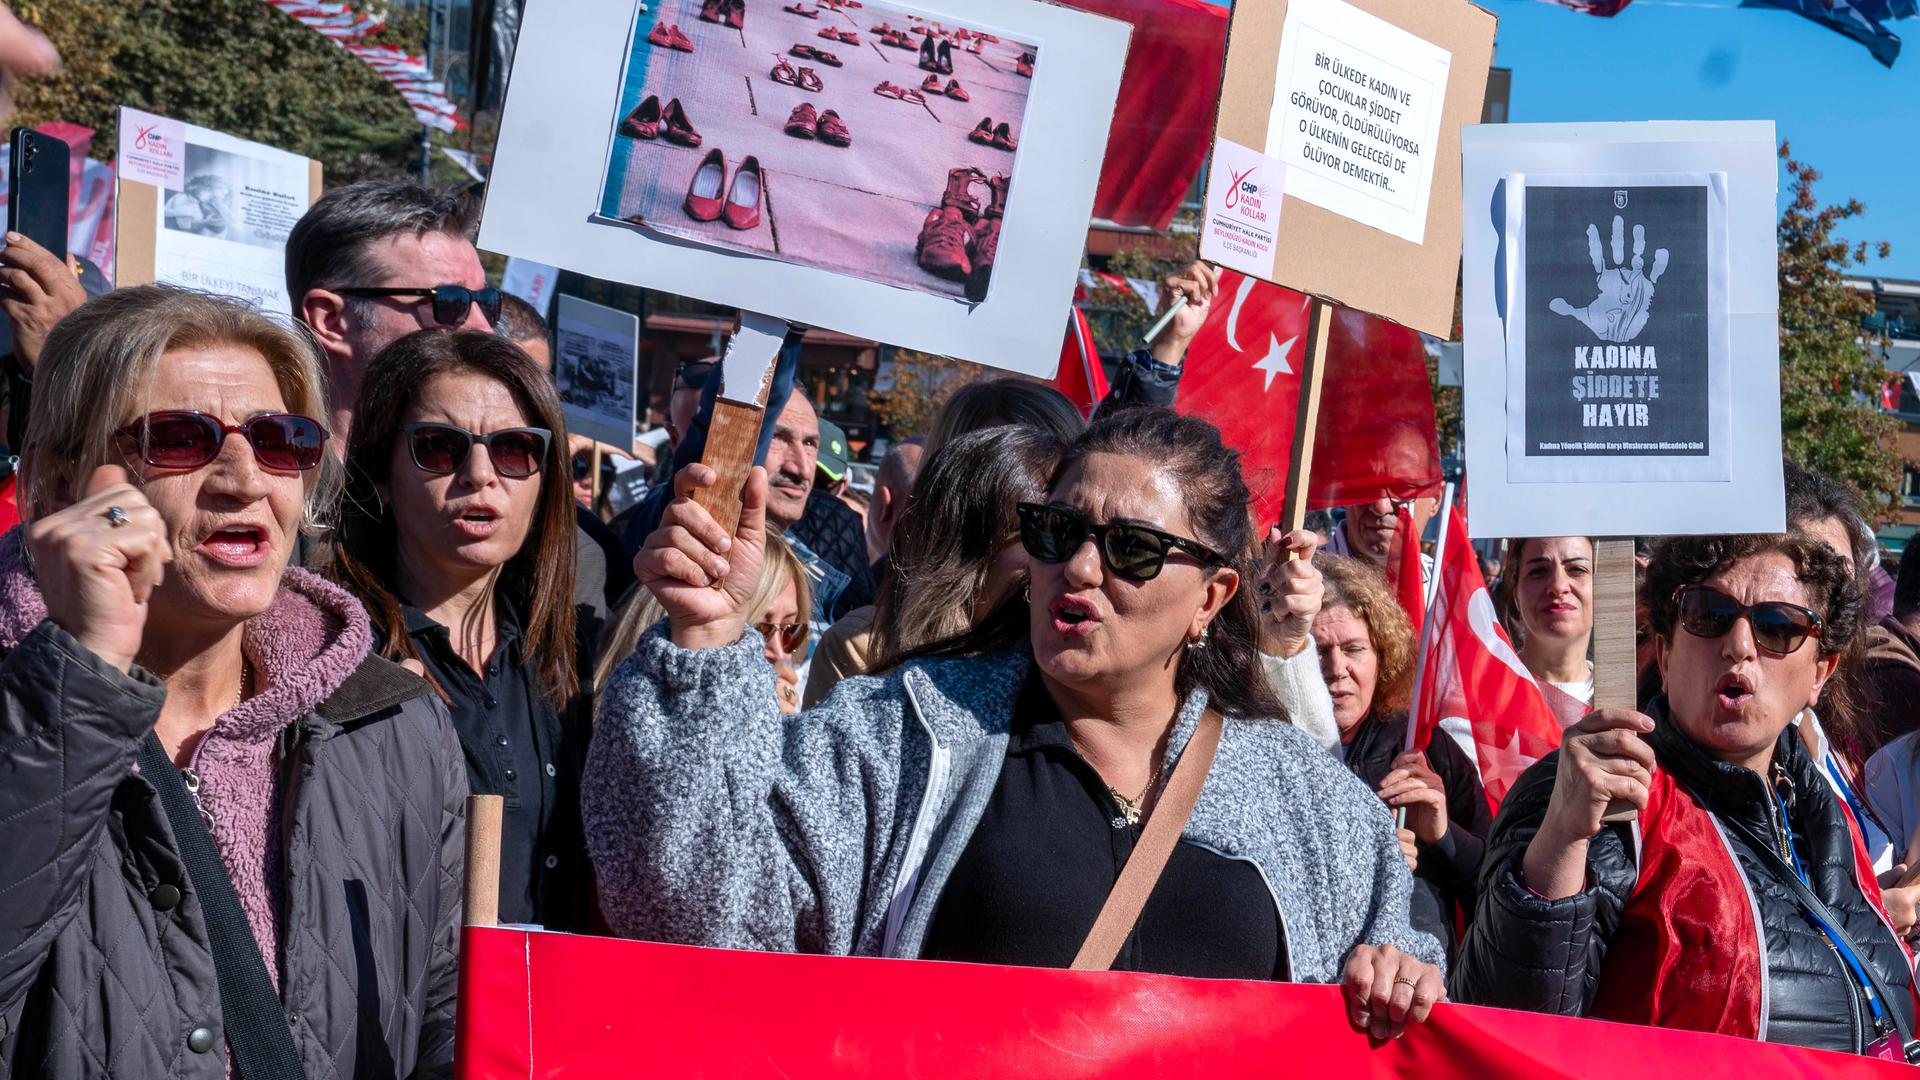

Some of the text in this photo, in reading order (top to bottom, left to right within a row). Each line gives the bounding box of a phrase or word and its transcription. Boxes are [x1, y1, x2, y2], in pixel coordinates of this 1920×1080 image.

[1315, 52, 1412, 107] BİR ÜLKEDE KADIN VE
[1318, 79, 1401, 125] ÇOCUKLAR ŞİDDET
[1291, 91, 1420, 157] GÖRÜYOR, ÖLDÜRÜLÜYORSA
[1299, 119, 1407, 174] O ÜLKENİN GELECEĞİ DE
[1303, 142, 1396, 194] ÖLÜYOR DEMEKTİR...
[1241, 181, 1258, 194] CHP
[1240, 193, 1262, 209] KADIN
[1240, 206, 1267, 222] KOLLARI
[1212, 218, 1242, 234] CUMHURİYET
[1242, 228, 1254, 238] HALK
[1242, 237, 1256, 248] KADIN
[1574, 344, 1658, 369] KADINA
[1572, 371, 1660, 401] ŞİDDETE
[1582, 402, 1650, 427] HAYIR
[1539, 442, 1704, 451] Kadına Yönelik Şiddete Karşı Uluslararası Mücadele Günü
